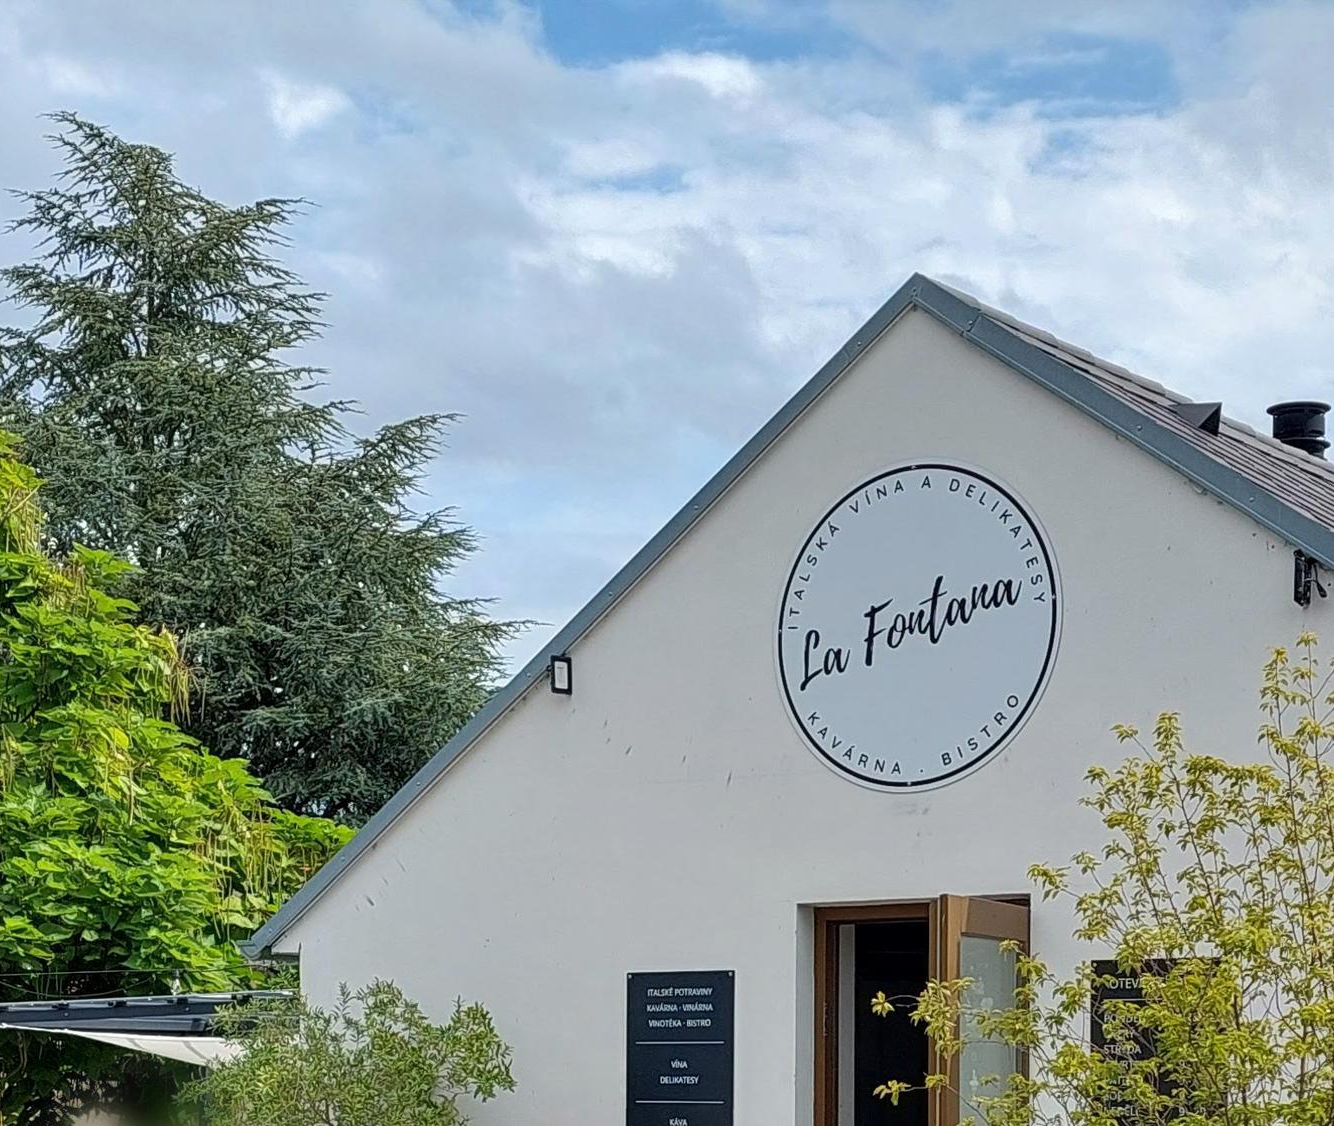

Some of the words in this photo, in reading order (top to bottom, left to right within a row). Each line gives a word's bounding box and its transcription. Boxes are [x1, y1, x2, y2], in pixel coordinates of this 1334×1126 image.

[787, 521, 840, 630] ITALSKÁ
[848, 479, 905, 515] VÍNA
[921, 475, 932, 489] A
[949, 478, 1045, 603] DELIKATESY
[799, 628, 851, 691] La
[863, 575, 1023, 667] Fontana
[807, 710, 903, 775] KAVÁRNA
[941, 694, 1020, 767] BISTRO
[647, 987, 673, 997] ITALSKÉ
[674, 988, 713, 997] POTRAVINY
[646, 1002, 678, 1012] KAVÁRNA
[682, 1002, 714, 1012] VINÁRNA
[648, 1018, 682, 1028] VINOTÉKA
[686, 1018, 712, 1027] BISTRO
[670, 1058, 688, 1069] VÍNA
[659, 1075, 700, 1085] DELIKATESY
[669, 1117, 688, 1126] KÁVA
